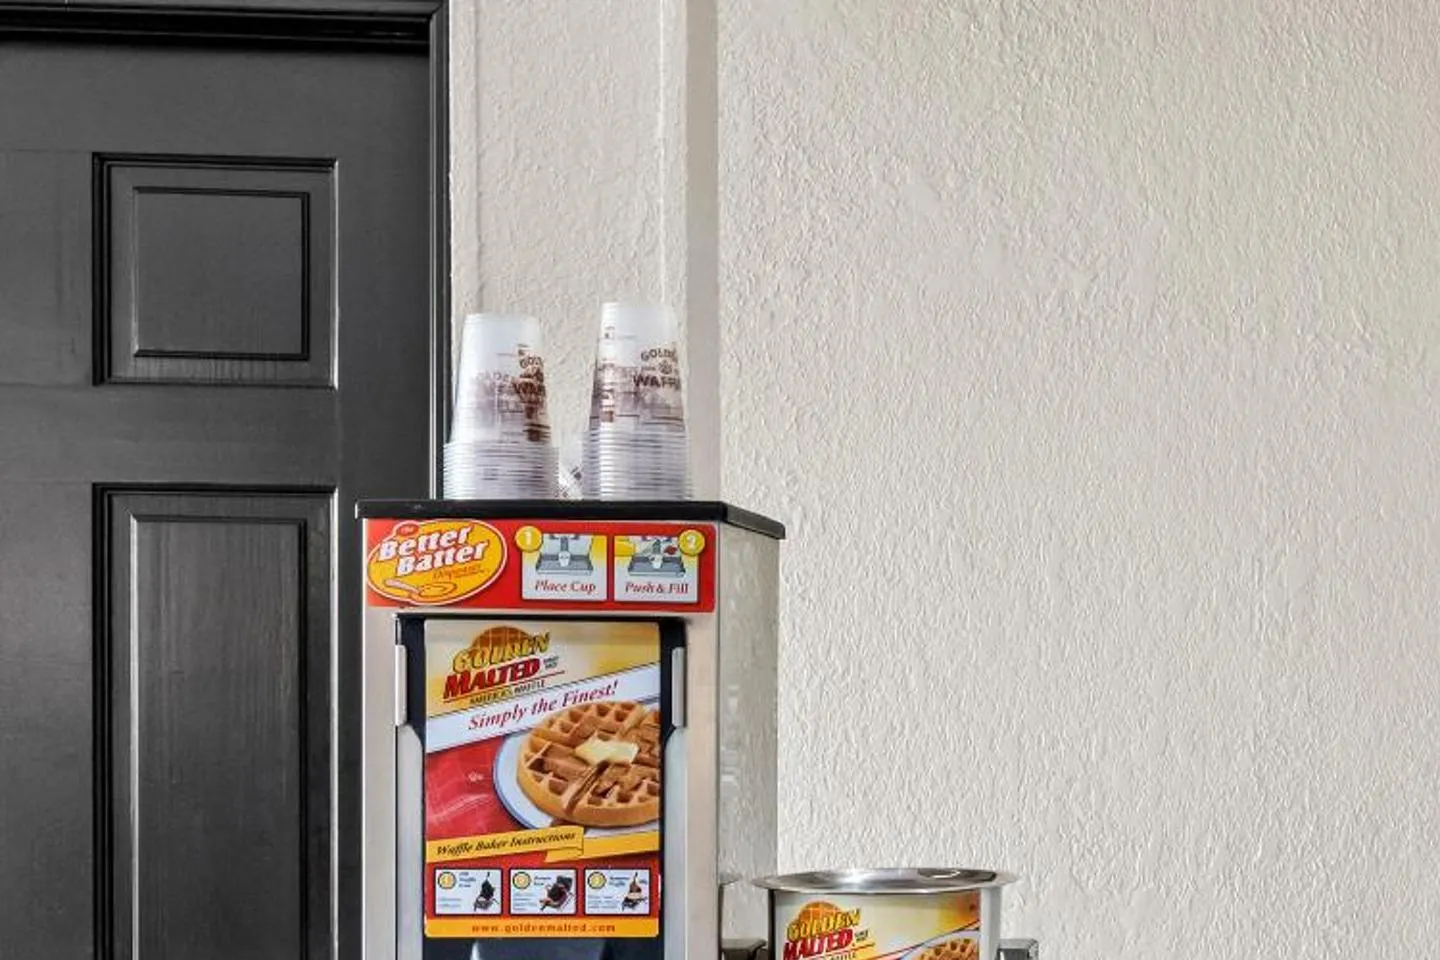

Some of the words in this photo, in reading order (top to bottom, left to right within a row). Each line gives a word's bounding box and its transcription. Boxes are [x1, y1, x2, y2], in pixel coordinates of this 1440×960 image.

[379, 526, 473, 562] Better
[523, 531, 533, 545] 1
[397, 541, 488, 577] Batter
[535, 579, 568, 594] Place
[571, 579, 597, 595] Cup
[625, 582, 655, 594] Push
[656, 582, 664, 594] &
[667, 582, 689, 595] Fill
[453, 631, 550, 674] GOLDEN
[443, 658, 541, 700] MALTED
[468, 706, 527, 731] Simply
[530, 697, 557, 713] the
[561, 680, 620, 710] Finest!
[437, 842, 474, 856] Waffle
[475, 838, 507, 852] Baker
[509, 831, 577, 848] Instructions
[470, 923, 617, 934] www.goldenmalted.com
[786, 907, 861, 943] GOLDEN
